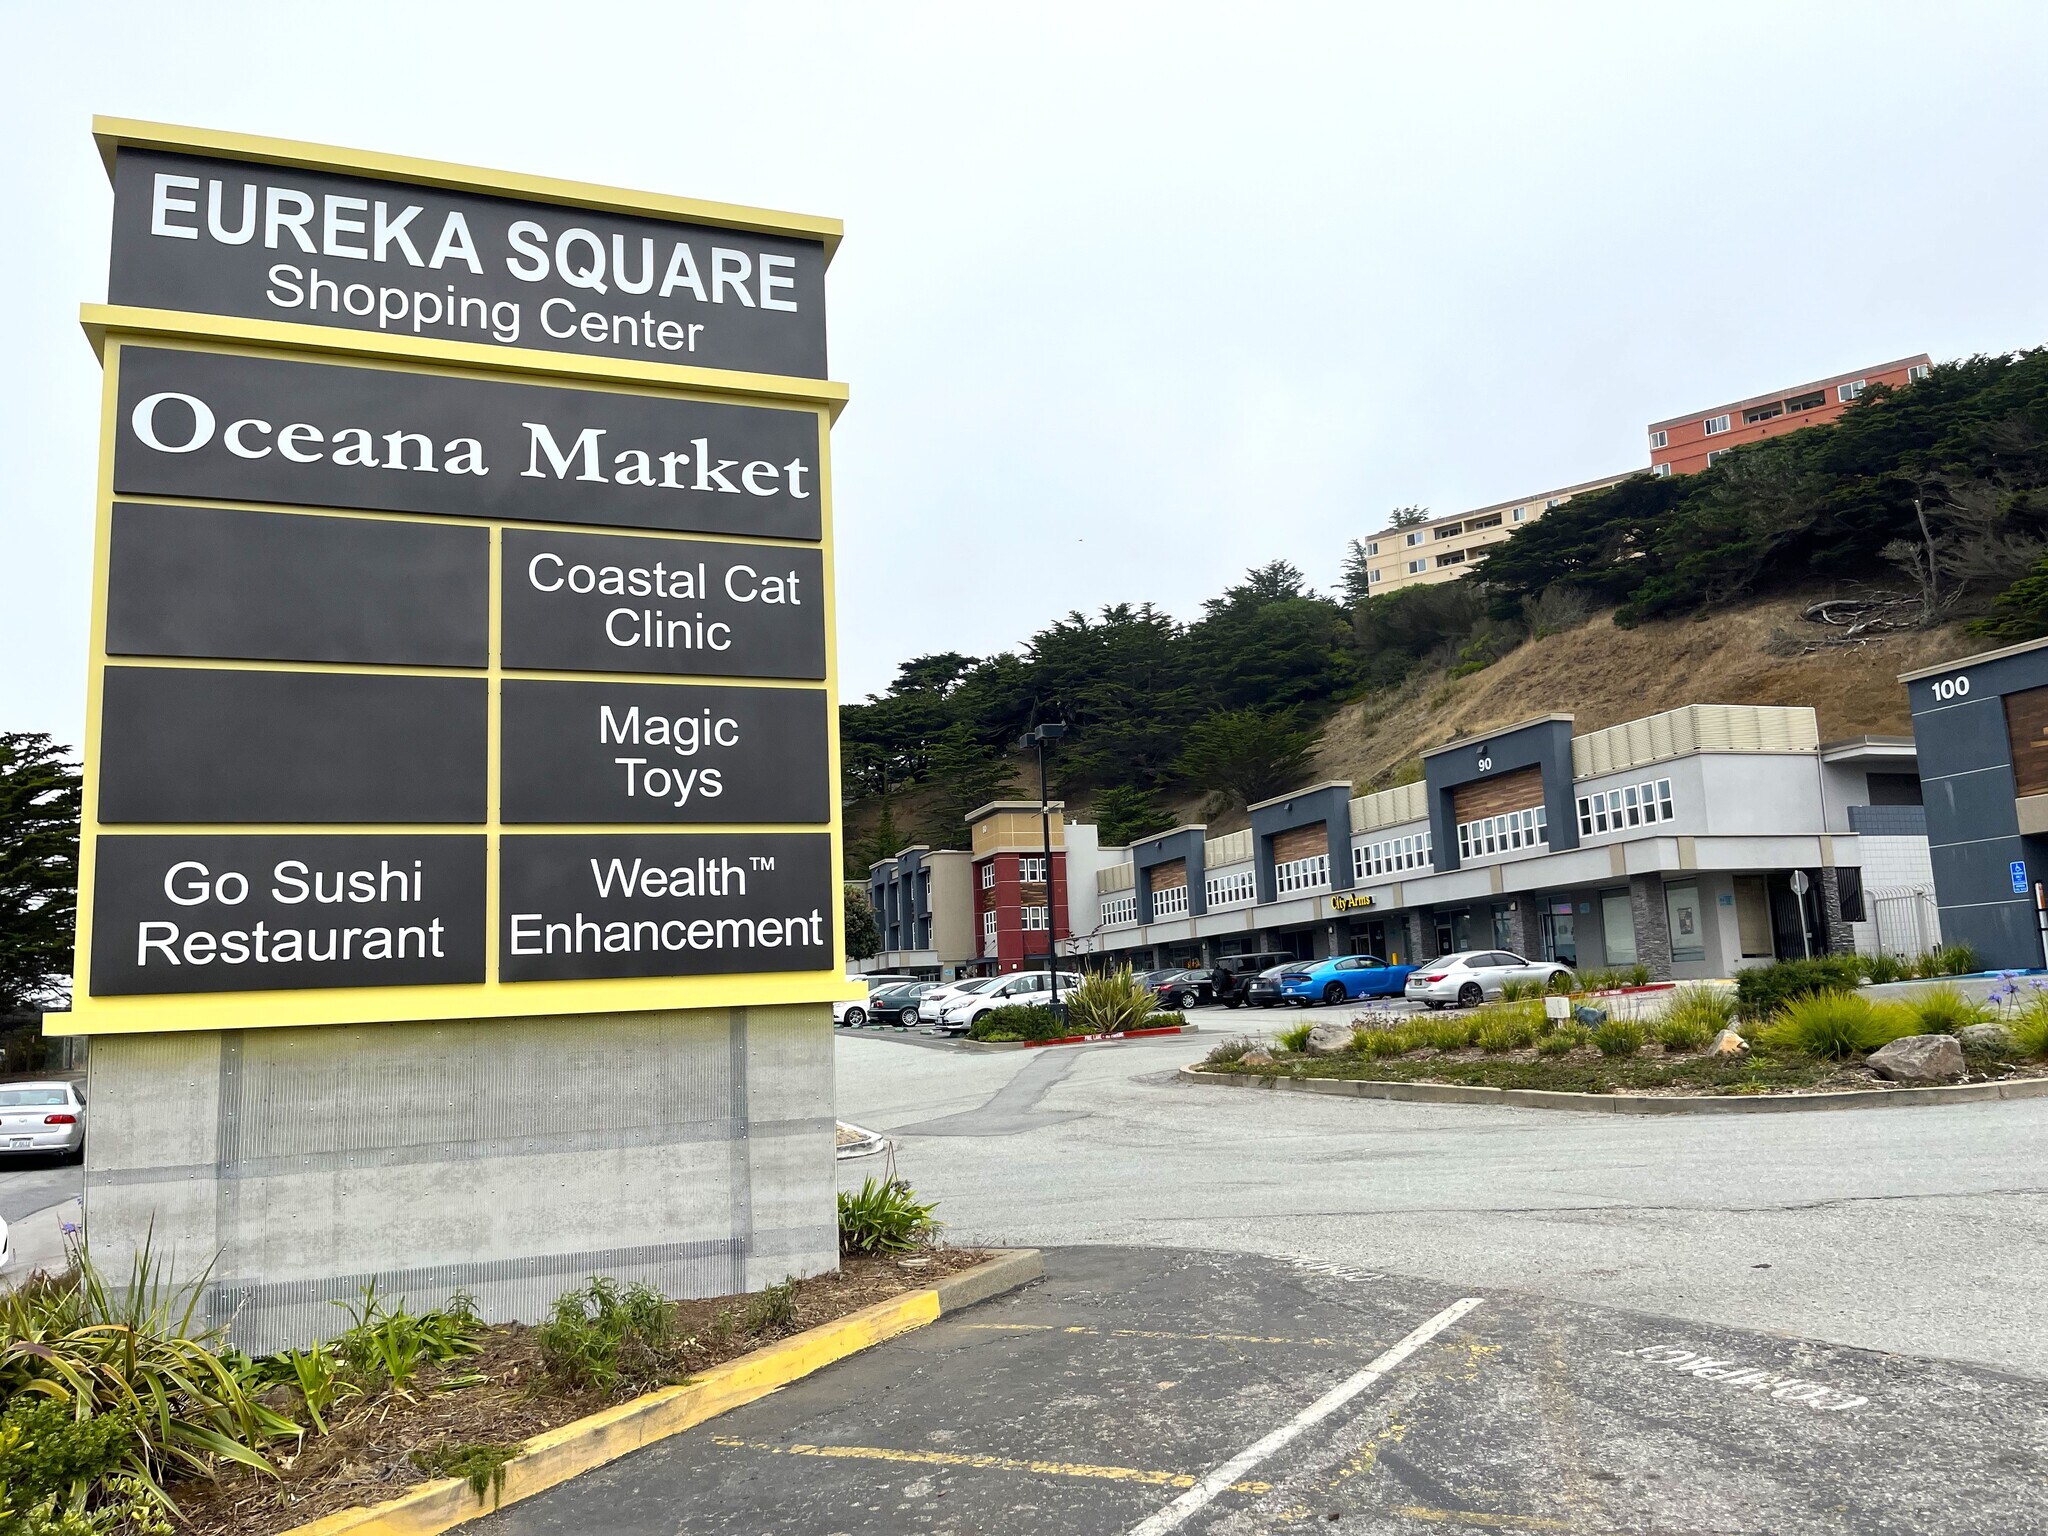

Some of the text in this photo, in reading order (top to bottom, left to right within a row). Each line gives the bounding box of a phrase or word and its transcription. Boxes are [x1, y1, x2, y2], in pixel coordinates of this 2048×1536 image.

[150, 173, 798, 313] EUREKA SQUARE
[266, 263, 705, 352] Shopping Center
[131, 392, 811, 499] Oceana Market
[528, 552, 801, 605] Coastal Cat
[605, 607, 732, 651] Clinic
[1931, 675, 1970, 701] 100
[600, 705, 739, 756] Magic
[614, 757, 723, 808] Toys
[1478, 757, 1492, 772] 90
[164, 860, 422, 906] Go Sushi
[1331, 893, 1371, 912] City Arms
[137, 917, 446, 966] Restaurant
[510, 908, 824, 955] Enhancement
